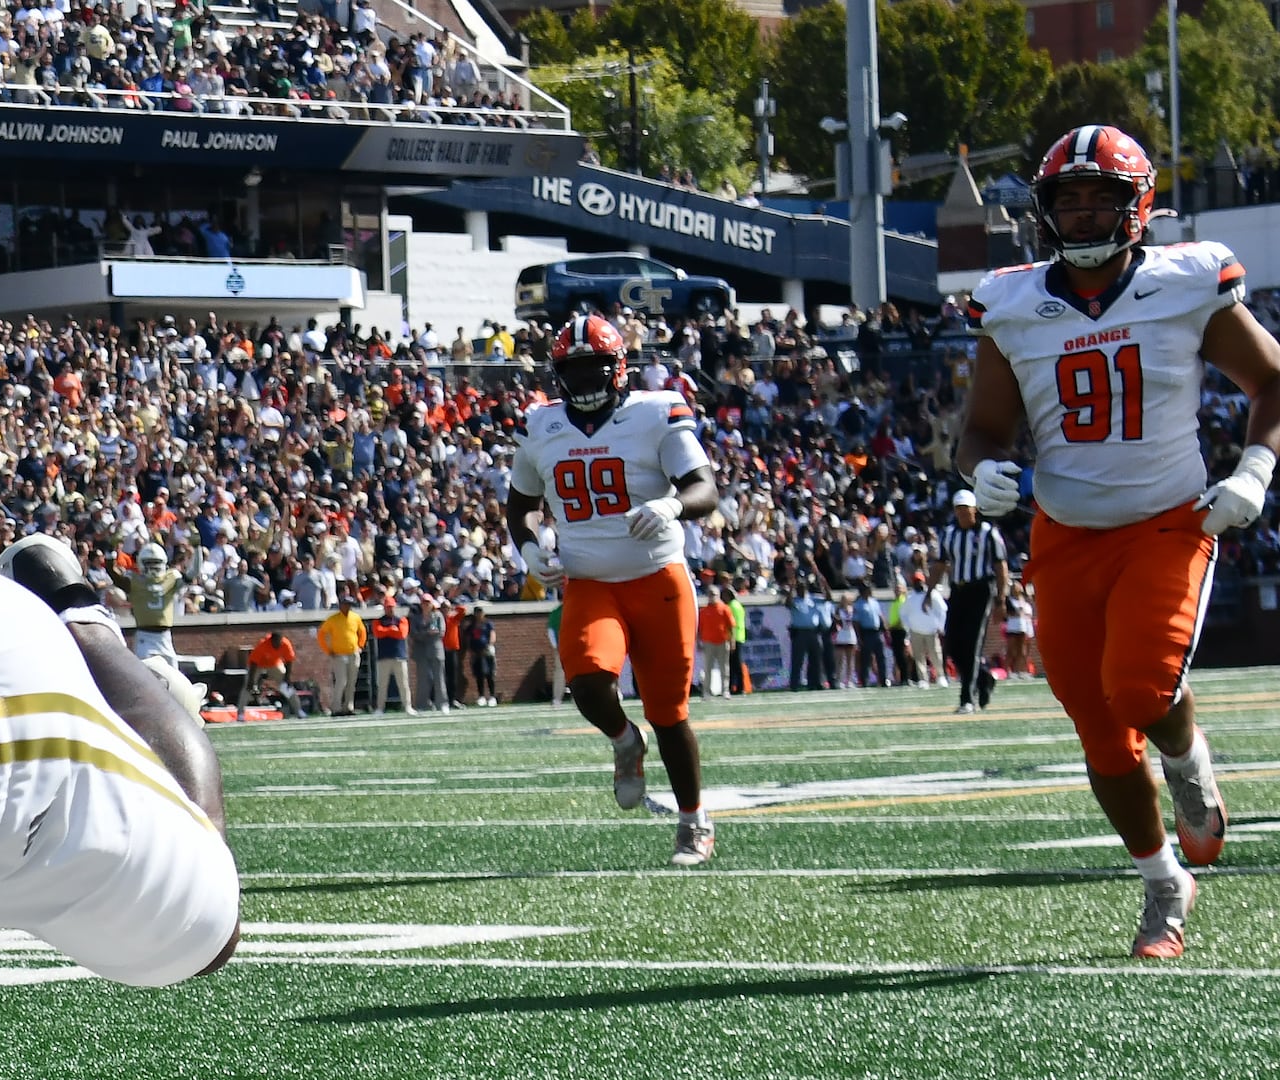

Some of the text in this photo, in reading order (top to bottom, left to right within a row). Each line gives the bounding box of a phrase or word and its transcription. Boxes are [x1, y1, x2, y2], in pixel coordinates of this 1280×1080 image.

[46, 124, 123, 145] JOHNSON
[161, 129, 278, 152] PAUL JOHNSON
[388, 137, 513, 166] COLLEGE HALL OF FAME
[532, 176, 777, 254] THE HYUNDAI NEST
[1064, 328, 1131, 351] ORANGE
[1055, 344, 1143, 443] 91
[553, 457, 632, 523] 99
